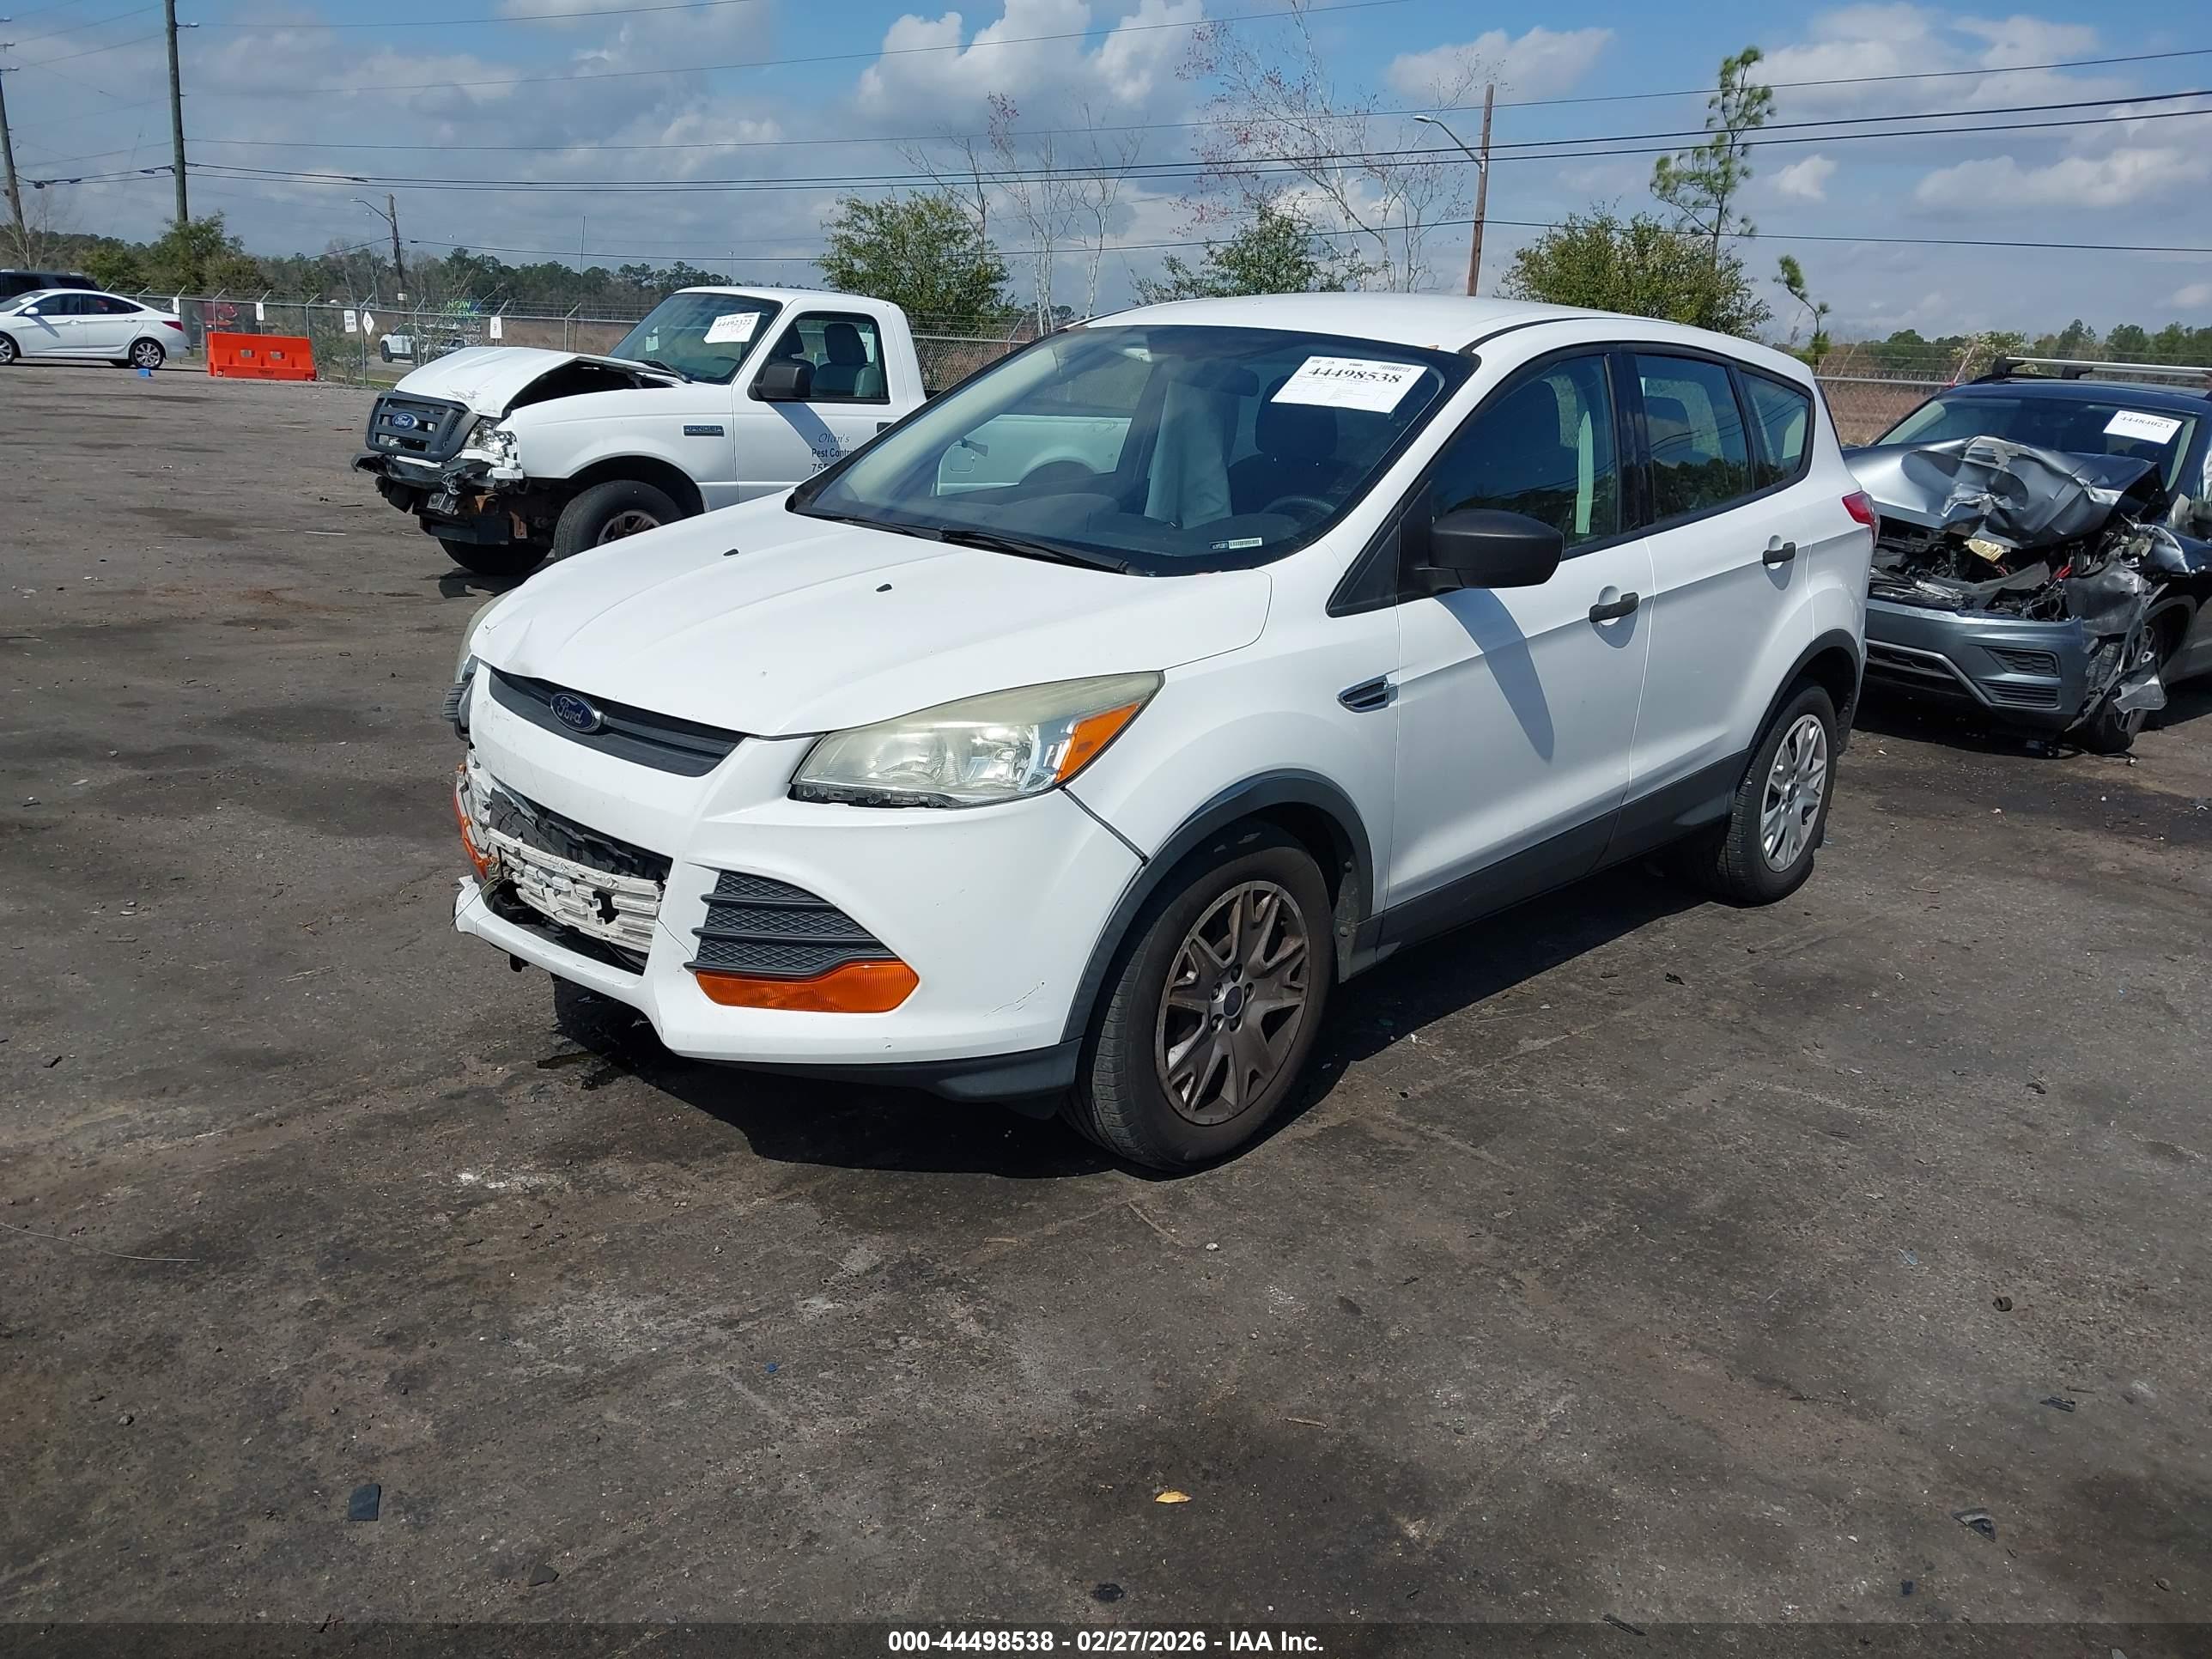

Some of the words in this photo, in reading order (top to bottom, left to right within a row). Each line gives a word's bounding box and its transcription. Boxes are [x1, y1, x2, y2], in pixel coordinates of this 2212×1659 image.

[447, 301, 471, 309] NOW
[1308, 367, 1402, 384] 44498538
[394, 415, 413, 426] Ford
[818, 432, 851, 444] Olan's
[811, 447, 829, 458] Pest
[556, 696, 585, 725] Ford
